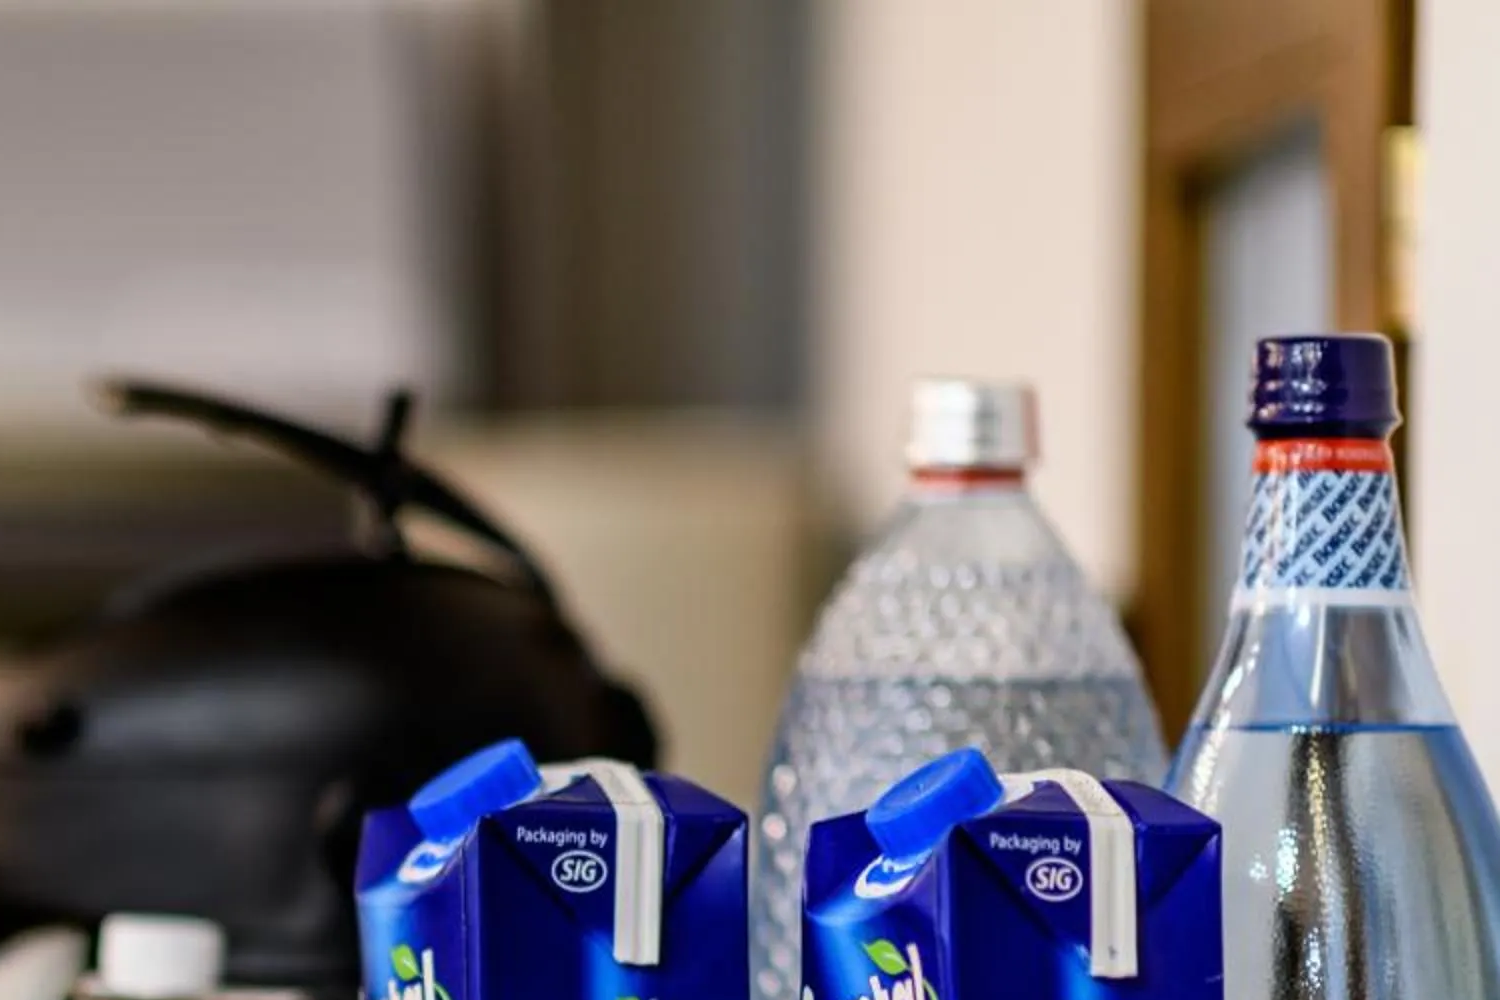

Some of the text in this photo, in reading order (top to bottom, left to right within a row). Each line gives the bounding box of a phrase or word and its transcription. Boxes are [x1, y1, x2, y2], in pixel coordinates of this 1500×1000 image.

[516, 826, 608, 848] Packaging by
[989, 832, 1082, 854] Packaging by
[559, 856, 599, 883] SIG
[1034, 866, 1073, 892] SIG
